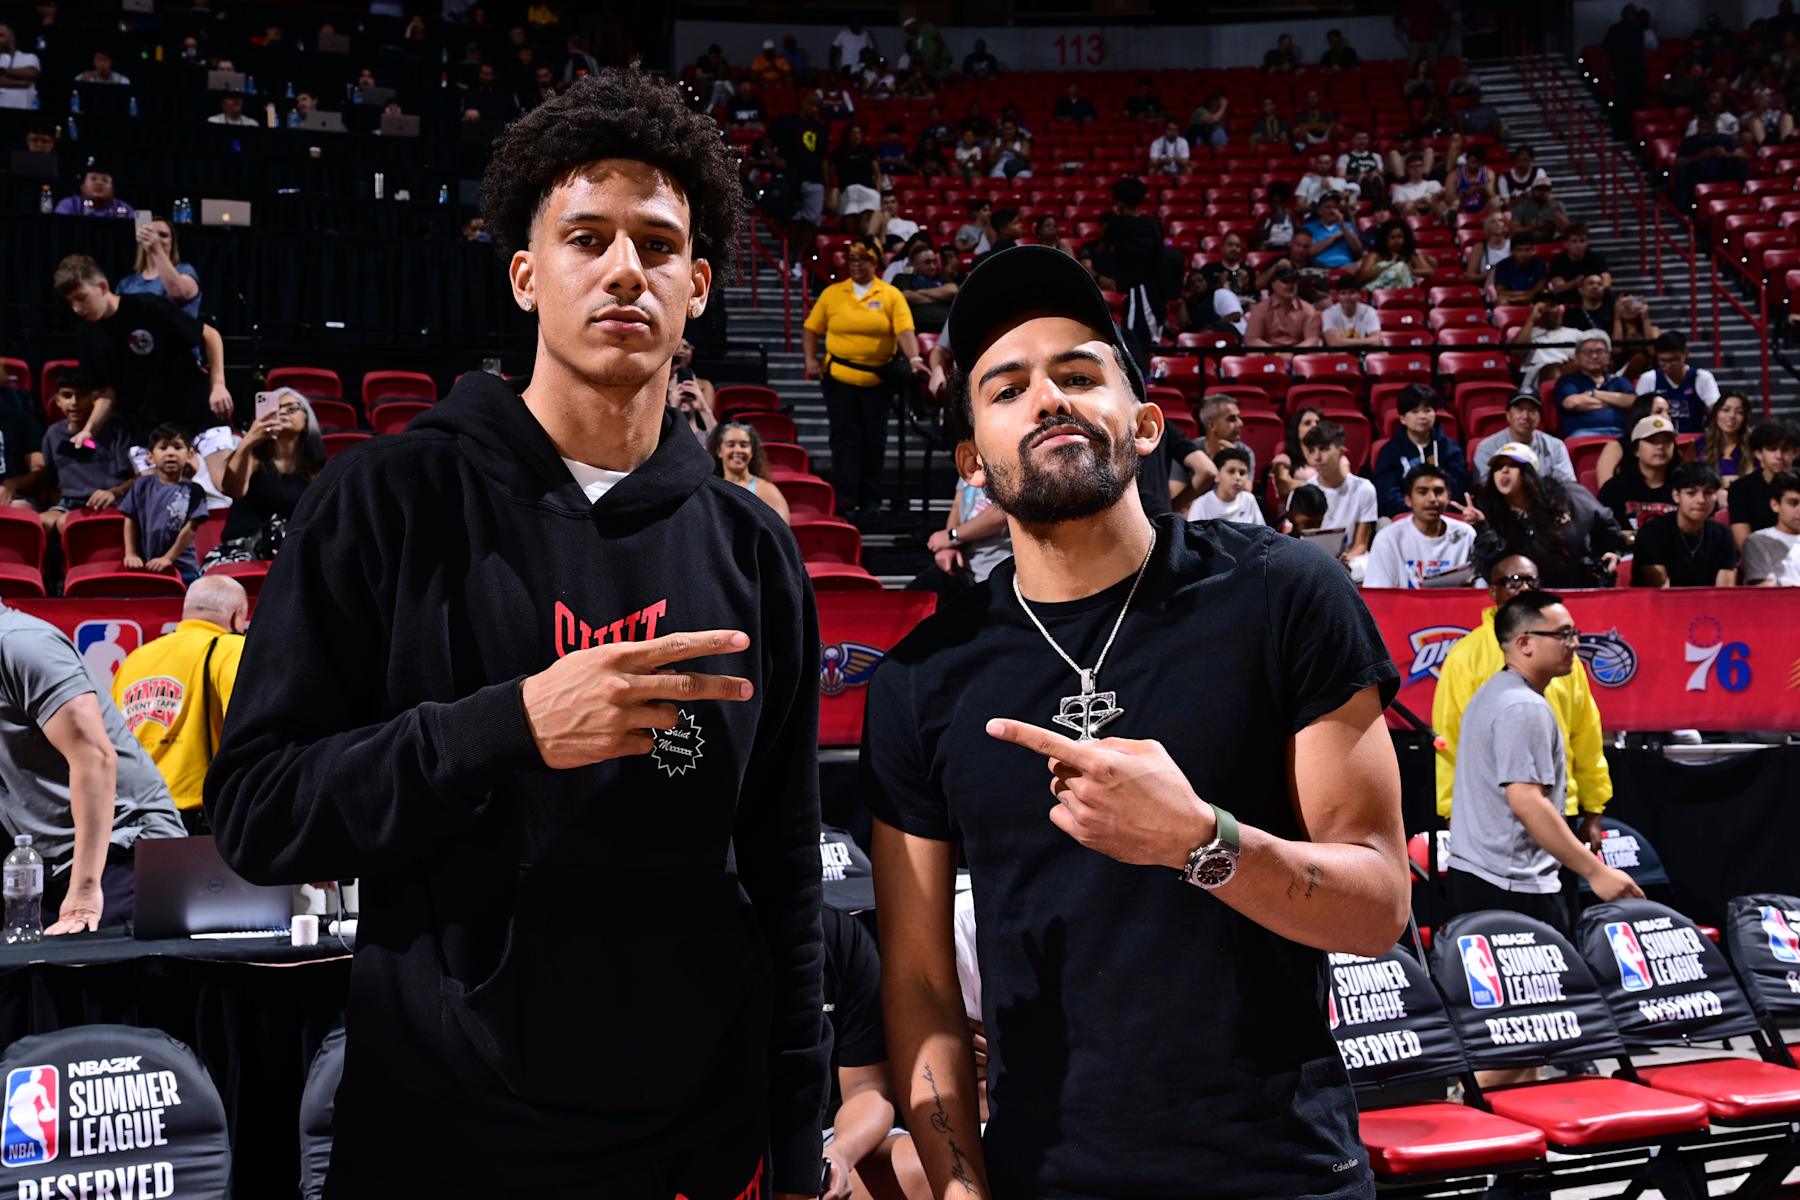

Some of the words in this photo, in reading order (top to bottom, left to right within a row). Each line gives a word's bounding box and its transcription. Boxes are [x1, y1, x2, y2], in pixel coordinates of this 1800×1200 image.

[1053, 33, 1105, 65] 113
[1685, 641, 1752, 692] 76
[1490, 932, 1536, 947] NBA2K
[1640, 927, 1706, 960] SUMMER
[1496, 944, 1569, 977] SUMMER
[1650, 953, 1708, 986] LEAGUE
[1333, 960, 1411, 997] SUMMER
[1505, 972, 1567, 1006] LEAGUE
[1340, 990, 1407, 1025] LEAGUE
[1638, 990, 1723, 1023] RESERVED
[1485, 1010, 1582, 1045] RESERVED
[68, 1055, 142, 1078] NBA2K
[1336, 1029, 1422, 1070] ESERVED
[68, 1070, 181, 1119] SUMMER
[69, 1108, 168, 1157] LEAGUE
[8, 1141, 36, 1160] NBA
[18, 1161, 175, 1200] RESERVED
